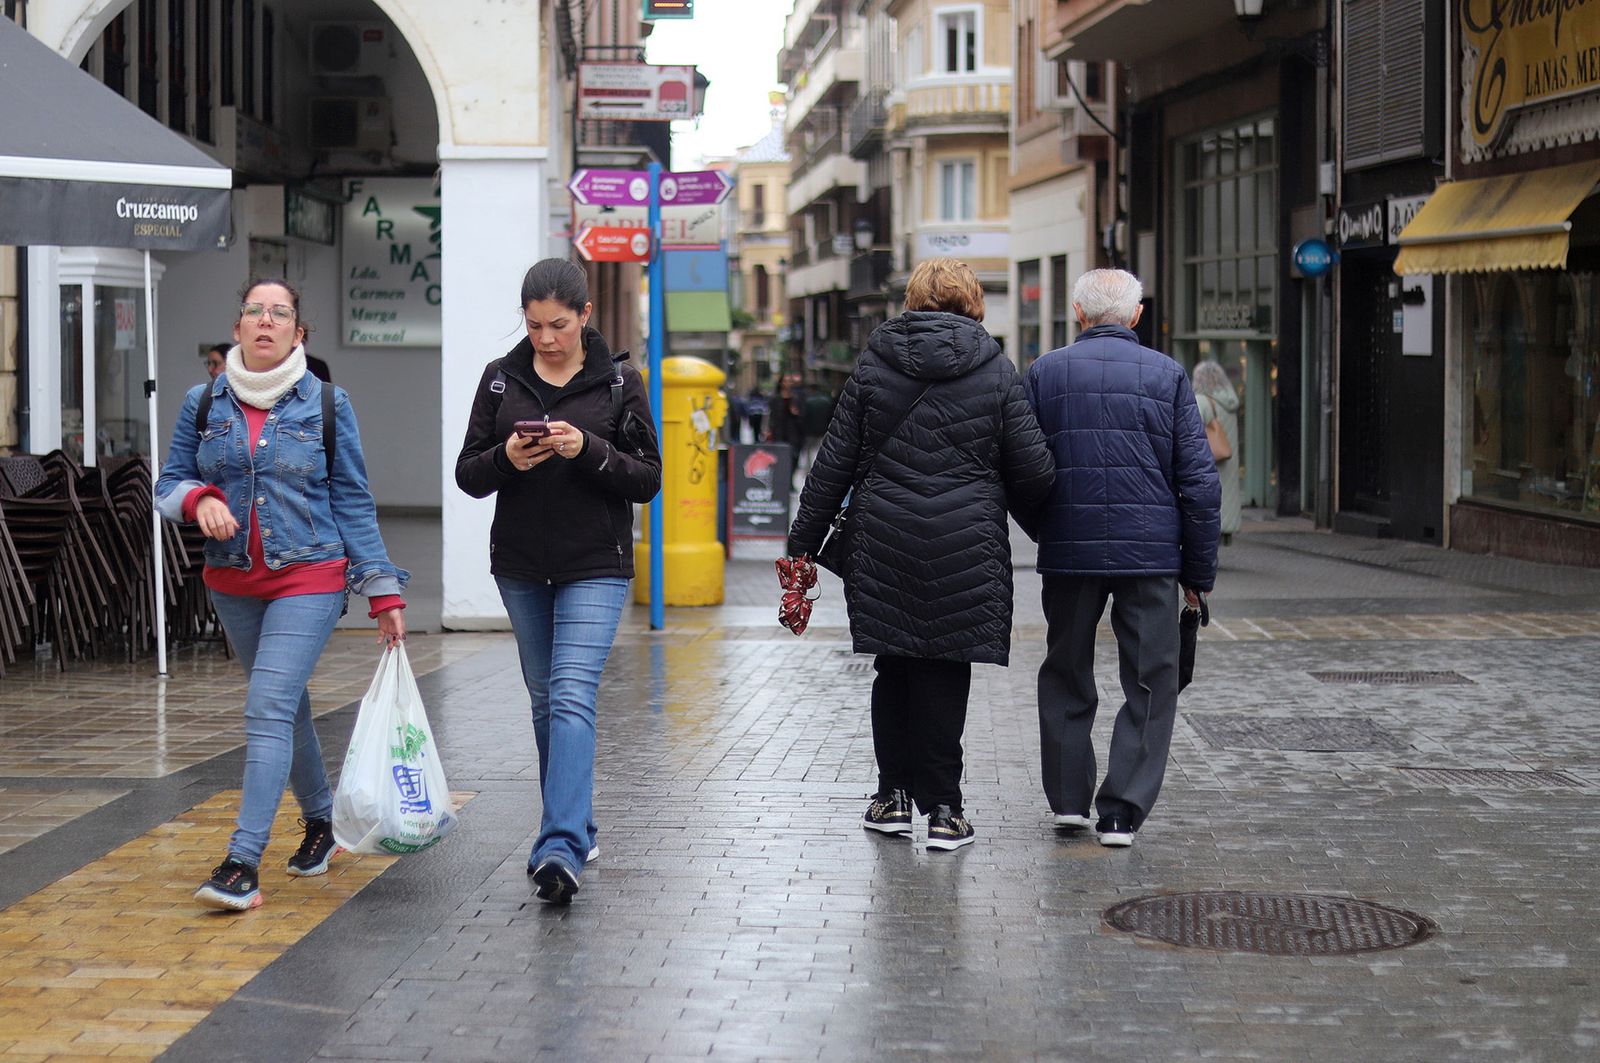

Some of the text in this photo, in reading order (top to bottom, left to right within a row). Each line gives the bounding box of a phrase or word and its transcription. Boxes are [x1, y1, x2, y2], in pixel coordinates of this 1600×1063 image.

[1524, 55, 1568, 97] LANAS
[116, 196, 198, 224] Cruzcampo
[133, 223, 182, 237] ESPECIAL
[349, 286, 405, 300] Carmen
[350, 306, 397, 323] Murga
[349, 328, 406, 343] Pascual
